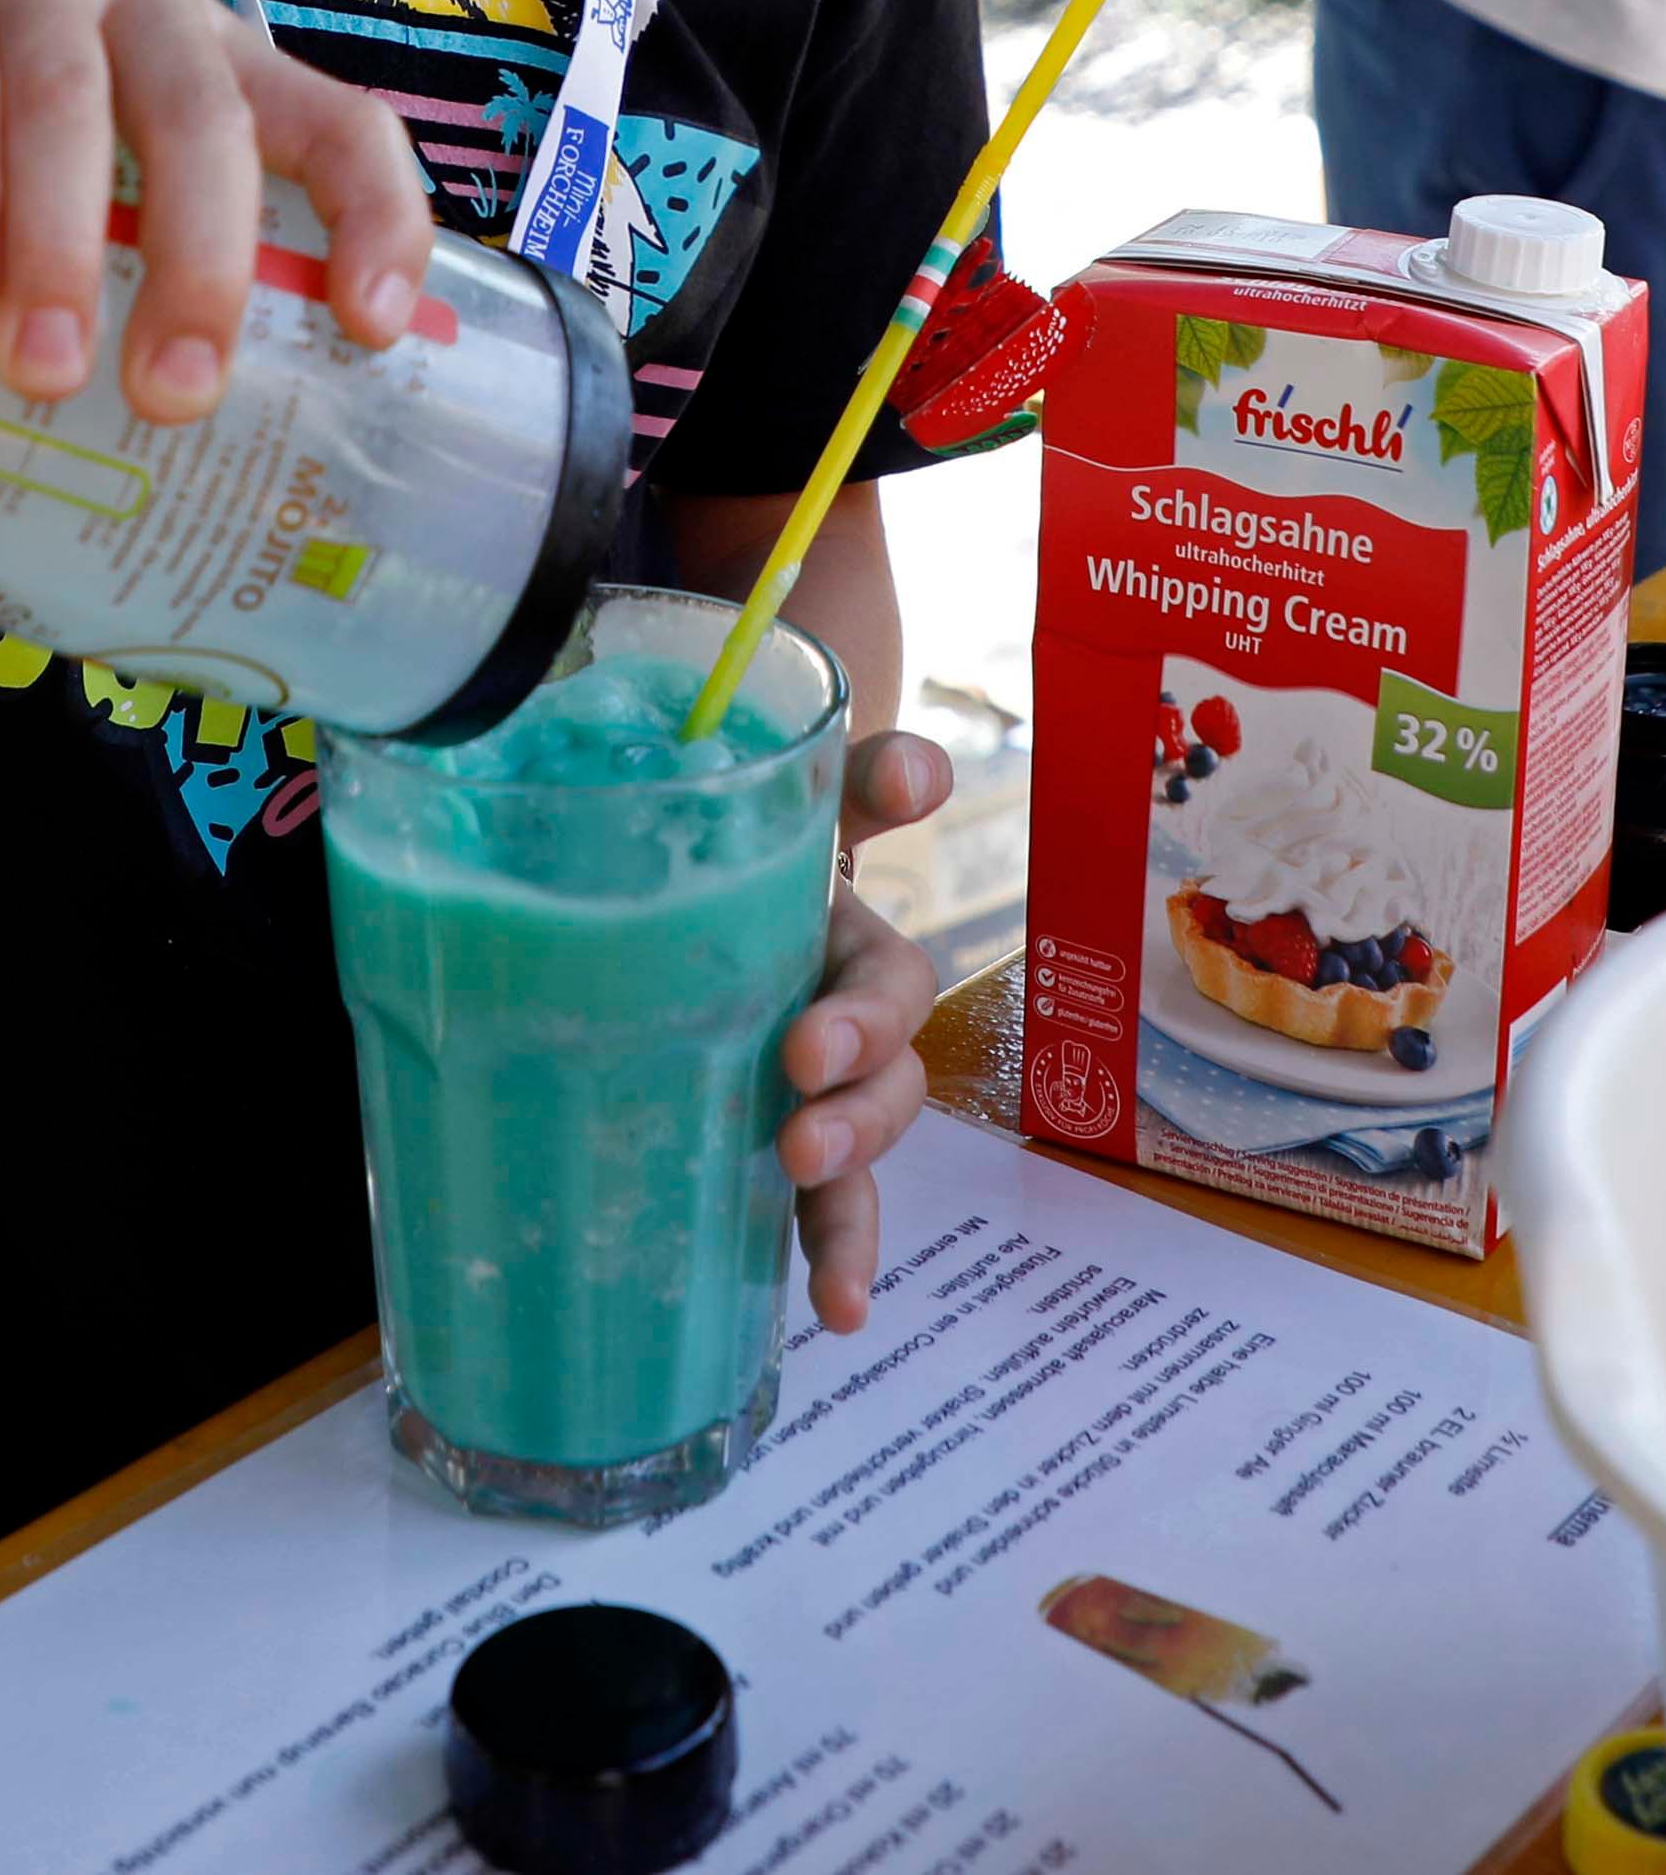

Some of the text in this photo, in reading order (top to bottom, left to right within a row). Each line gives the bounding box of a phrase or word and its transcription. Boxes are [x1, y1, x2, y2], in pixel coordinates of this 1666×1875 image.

[521, 126, 587, 262] FORCHHEIM
[555, 166, 595, 228] mini-
[1232, 286, 1368, 312] ultrahocherhitzt
[1232, 383, 1414, 463] frischli
[232, 454, 327, 613] MOJITO
[1130, 483, 1374, 565] Schlagsahne
[1174, 541, 1325, 587] ultrahocherhitzt
[1086, 555, 1409, 656] Whipping Cream
[1224, 631, 1263, 656] UHT
[1392, 712, 1446, 763] 32
[905, 1228, 959, 1268] einem
[953, 1215, 990, 1237] Mit
[926, 1231, 1032, 1300] Ale auffüllen.
[971, 1245, 1064, 1311] Flüssigkeit
[1026, 1264, 1104, 1315] schütteln.
[781, 1313, 827, 1352] hren
[928, 1313, 960, 1334] ein
[955, 1297, 982, 1315] in
[1118, 1306, 1211, 1372] zerdrücken.
[830, 1327, 936, 1403] Cocktailglas
[710, 1276, 1138, 1579] Eiswürfeln auffüllen. Shaker verschließen und kräftig
[770, 1399, 834, 1446] gießen
[810, 1288, 1168, 1547] Maracujasaft abmessen, hinzugeben und mit
[1234, 1370, 1373, 1481] 100 ml Ginger Ale
[729, 1444, 773, 1476] und
[823, 1319, 1242, 1641] zusammen mit dem Zucker in den Shaker geben und
[933, 1332, 1277, 1597] Eine halbe Limette in Stücke schneiden und
[1268, 1389, 1422, 1518] 100 ml Maracujasaft
[1322, 1405, 1477, 1542] 2 EL brauner Zucker
[1447, 1439, 1514, 1497] Limette
[1546, 1488, 1614, 1548] nema
